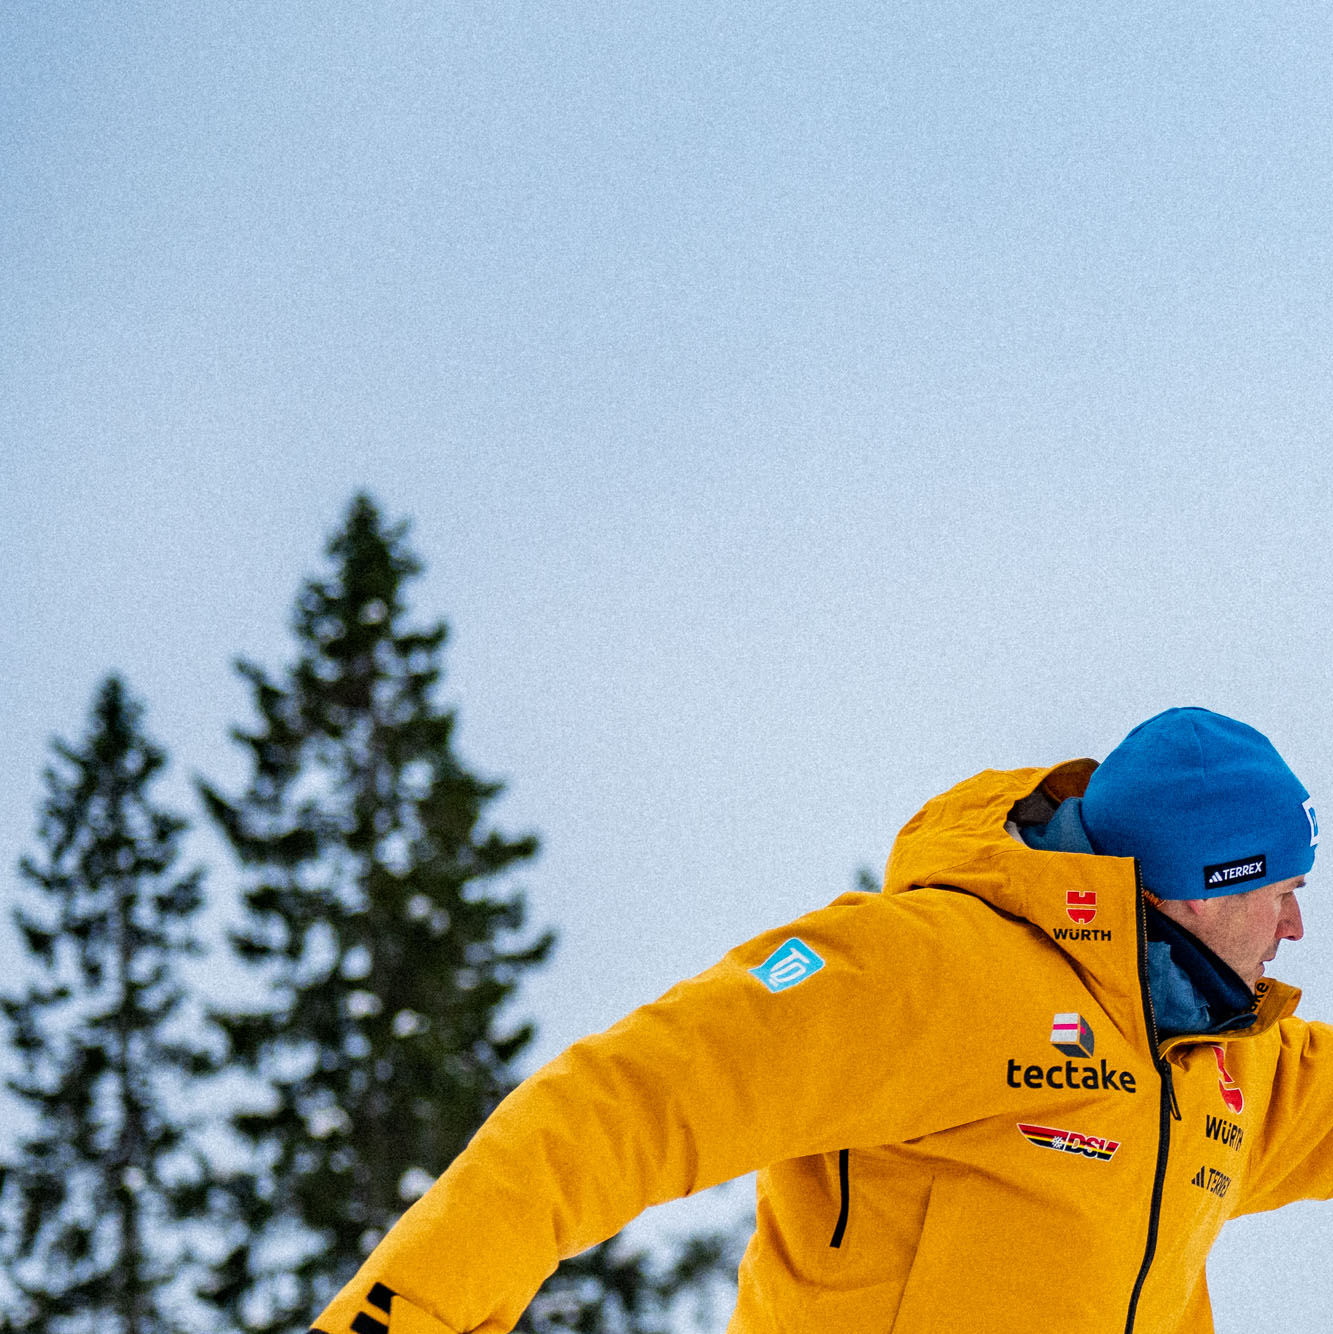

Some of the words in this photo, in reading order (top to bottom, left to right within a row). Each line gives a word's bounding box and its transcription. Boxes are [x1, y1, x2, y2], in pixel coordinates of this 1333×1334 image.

[1222, 861, 1264, 881] TERREX
[1053, 928, 1112, 942] WÜRTH
[1006, 1058, 1137, 1094] tectake
